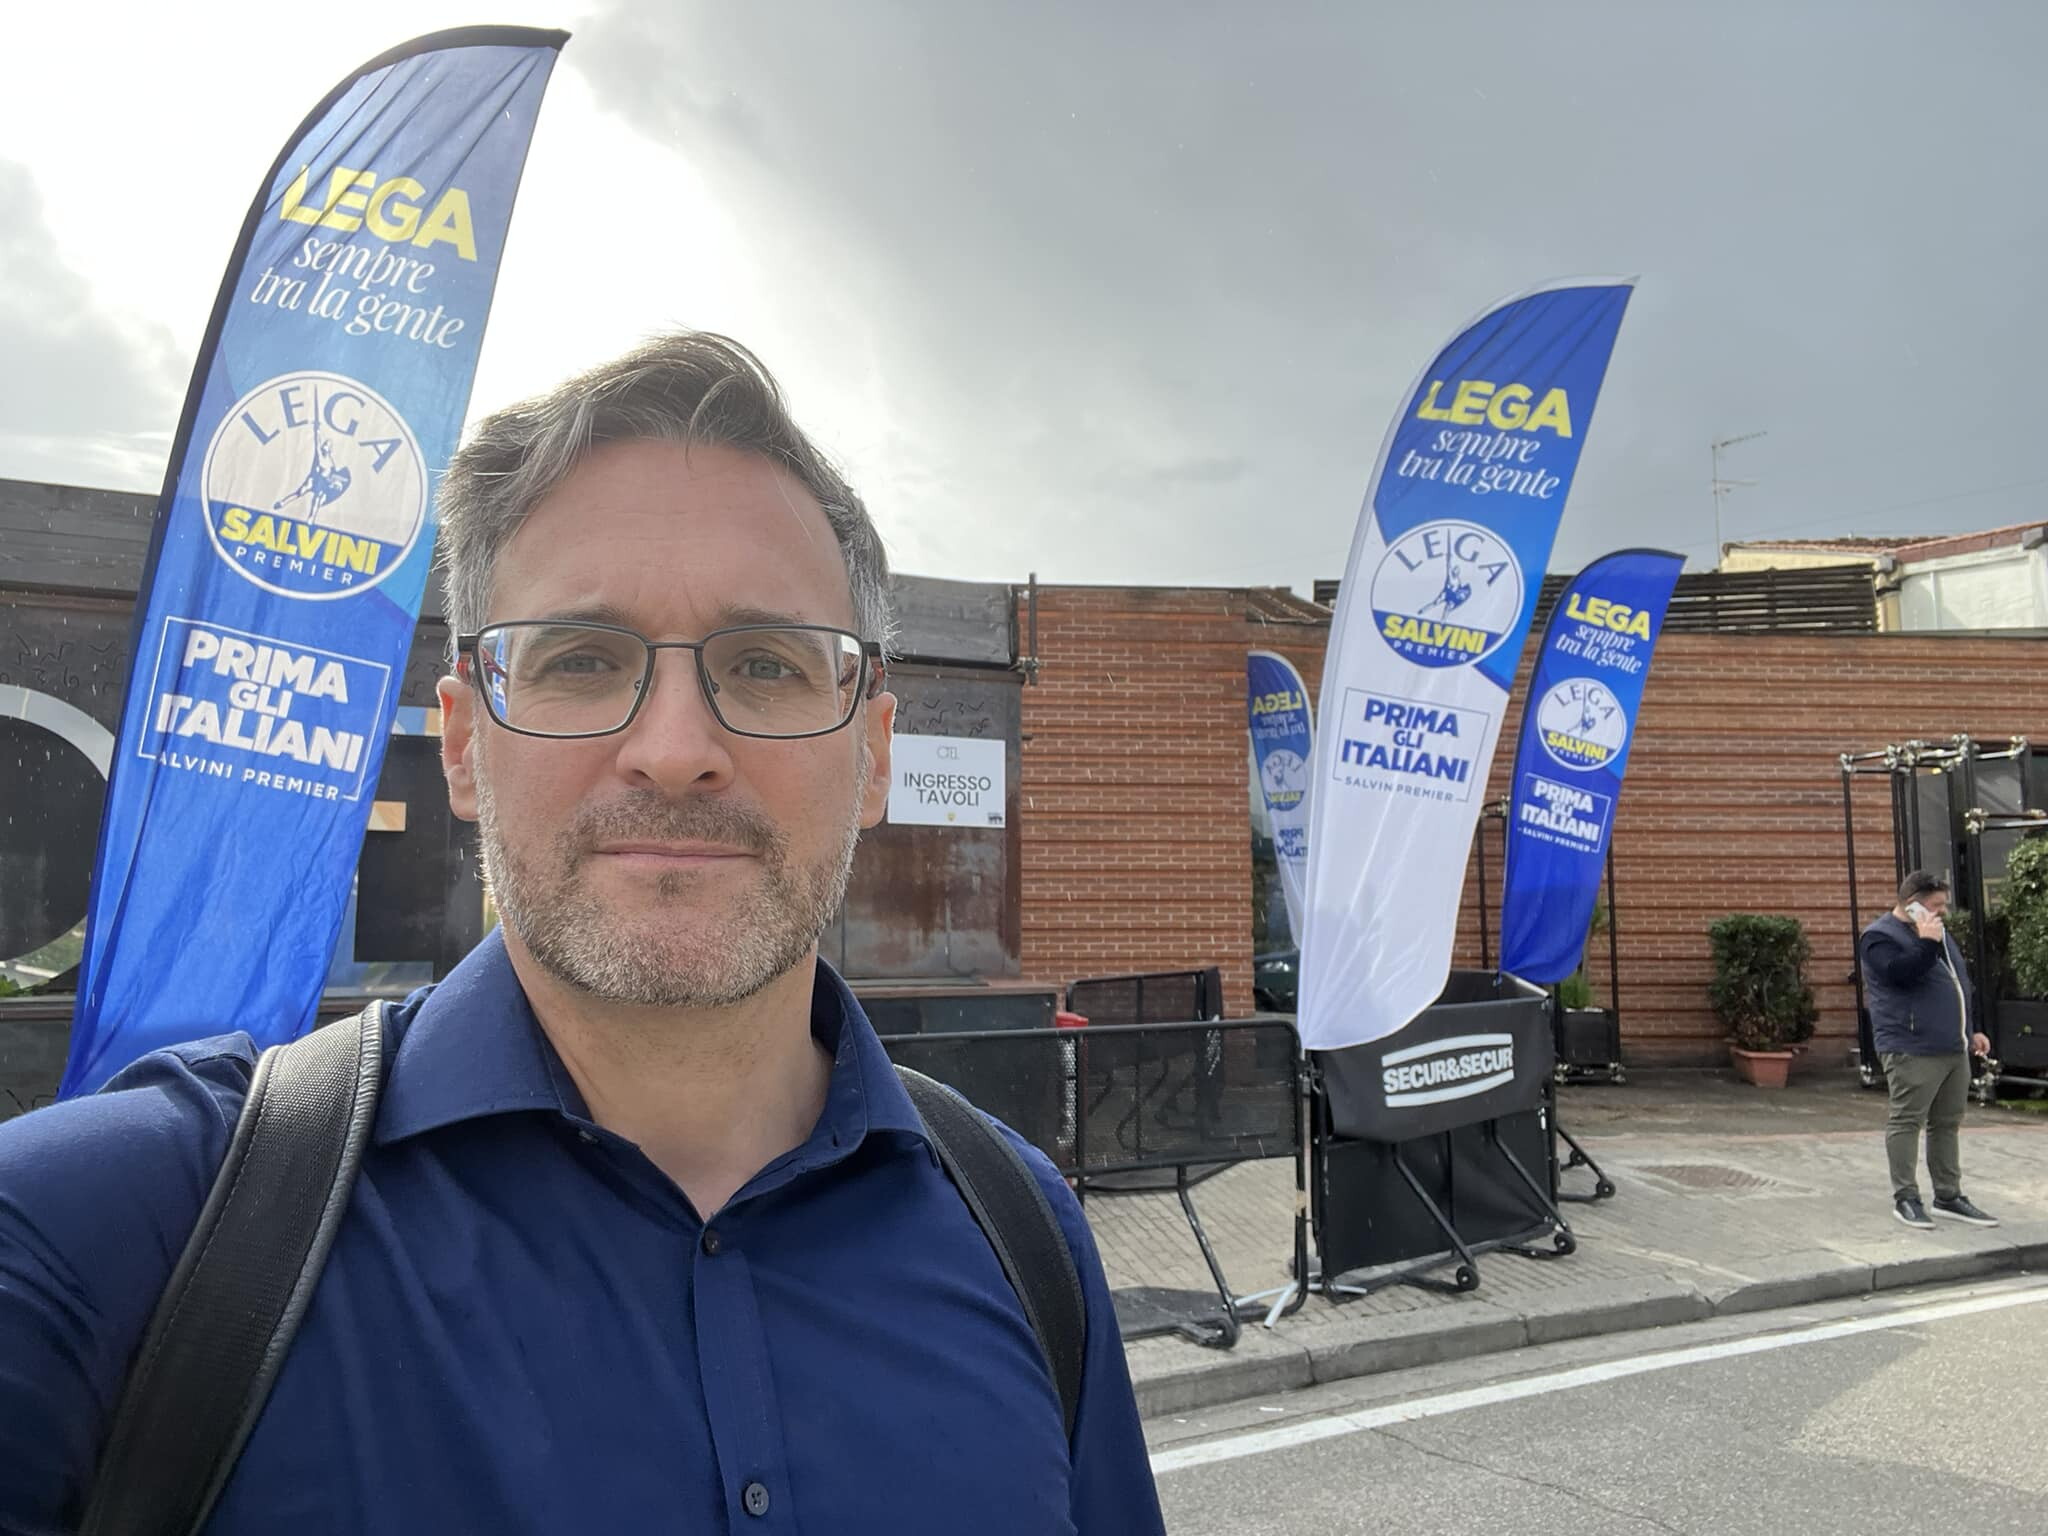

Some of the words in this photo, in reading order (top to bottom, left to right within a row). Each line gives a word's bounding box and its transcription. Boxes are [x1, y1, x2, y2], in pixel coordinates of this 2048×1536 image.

[280, 165, 478, 261] LEGA
[294, 237, 435, 294] sempre
[251, 267, 307, 310] tra
[308, 271, 350, 320] la
[345, 292, 465, 349] gente
[1417, 380, 1572, 438] LEGA
[241, 386, 403, 474] LEGA
[1432, 430, 1541, 463] sempre
[1398, 449, 1444, 480] tra
[1444, 452, 1476, 485] la
[1471, 463, 1561, 499] gente
[219, 507, 381, 576] SALVINI
[1395, 530, 1509, 587] LEGA
[235, 546, 353, 585] PREMIER
[1383, 614, 1488, 654] SALVINI
[1566, 592, 1650, 641] LEGA
[183, 629, 348, 704] PRIMA
[1393, 640, 1468, 661] PREMIER
[1596, 649, 1642, 674] gente
[229, 681, 293, 719] GLI
[1364, 698, 1459, 738] PRIMA
[1554, 685, 1615, 720] LEGA
[155, 693, 364, 773] ITALIANI
[1393, 729, 1424, 749] GLI
[1547, 731, 1608, 761] SALVINI
[1342, 739, 1470, 783] ITALIANI
[242, 768, 339, 800] PREMIER
[904, 772, 992, 791] INGRESSO
[917, 789, 979, 806] TAVOLI
[1396, 783, 1453, 802] PREMIER
[1534, 780, 1593, 813] PRIMA
[1521, 802, 1600, 842] ITALIANI
[1551, 802, 1573, 817] GLI
[1383, 1047, 1513, 1094] SECUR&SECUR
